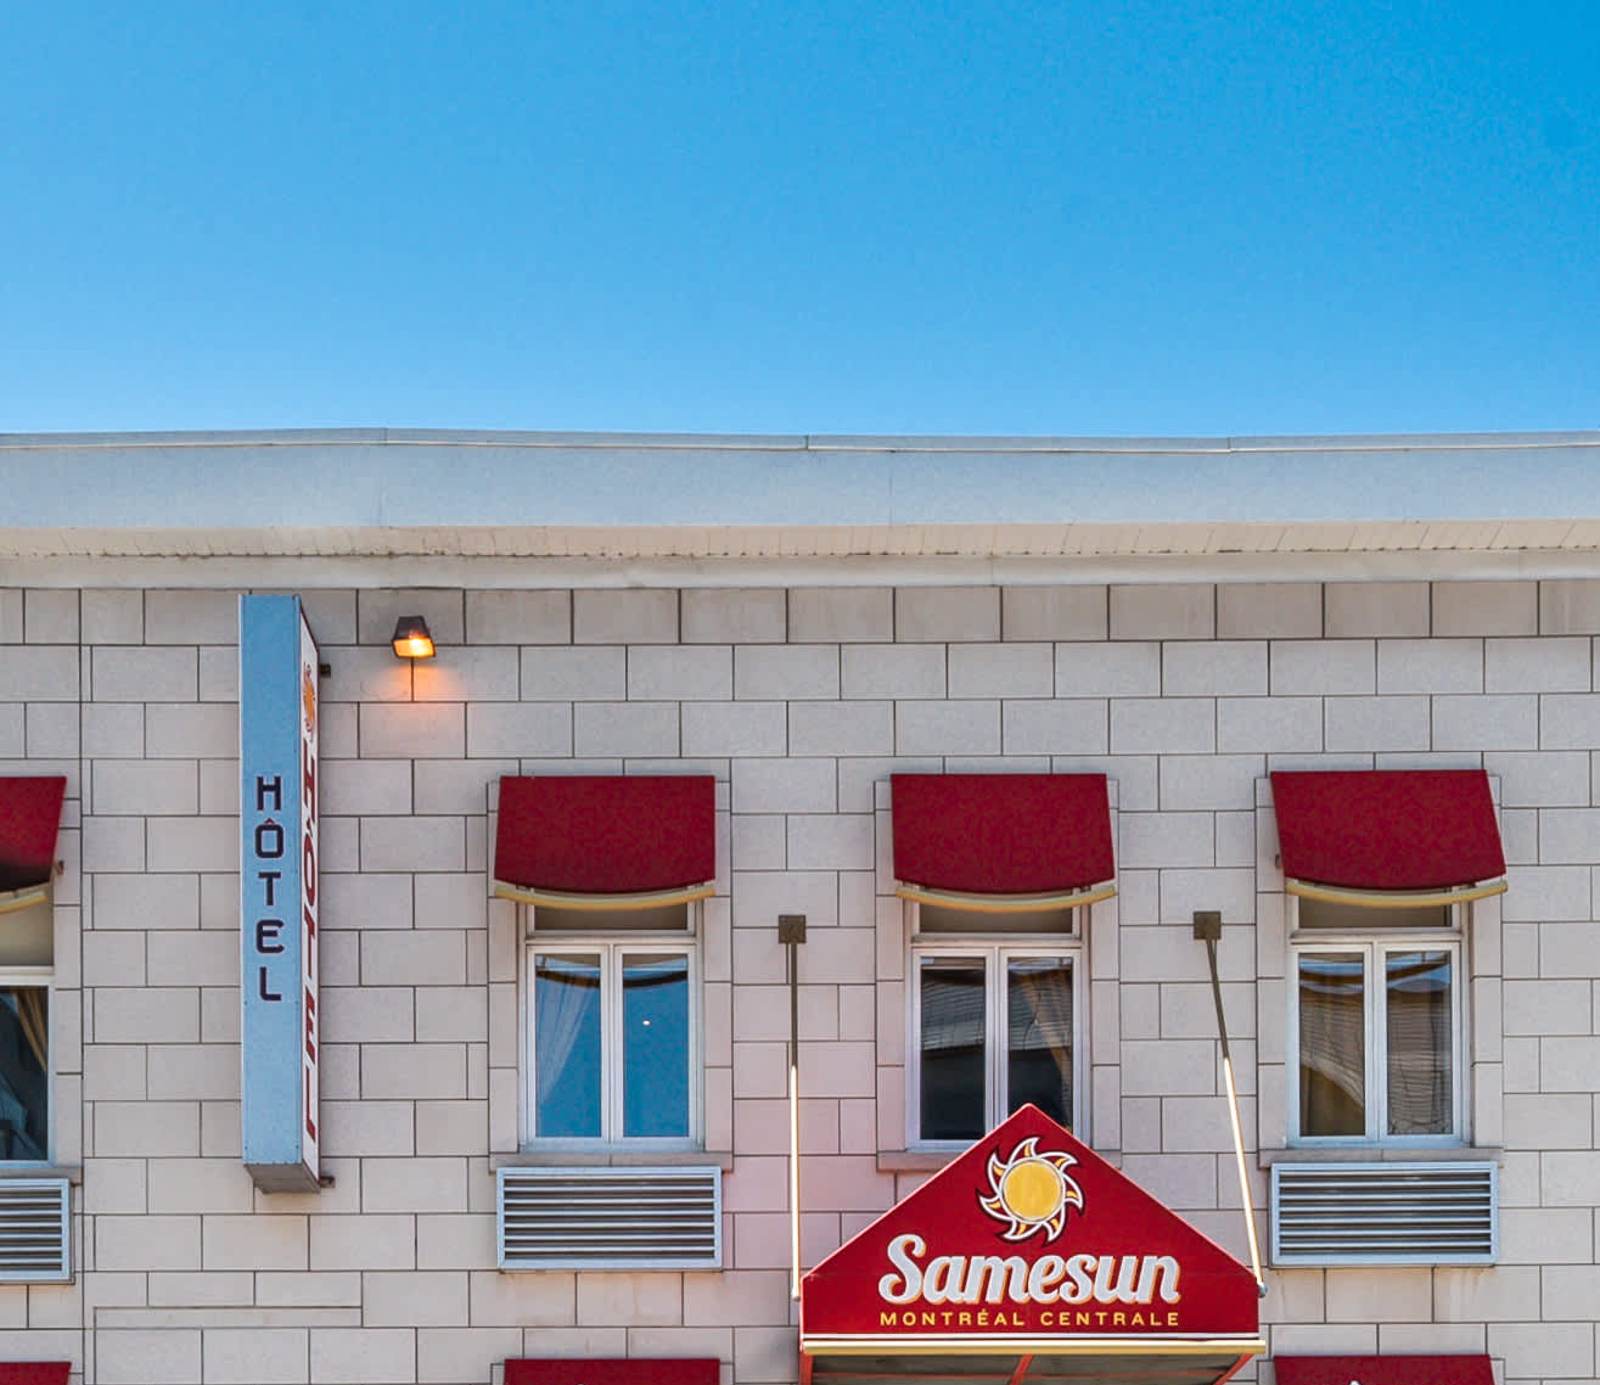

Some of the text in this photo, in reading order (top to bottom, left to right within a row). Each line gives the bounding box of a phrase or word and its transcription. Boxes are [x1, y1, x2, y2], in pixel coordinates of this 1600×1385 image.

[256, 775, 285, 1002] HÔTEL
[878, 1233, 1181, 1305] Samesun
[880, 1308, 1180, 1326] MONTRÉAL CENTRALE
